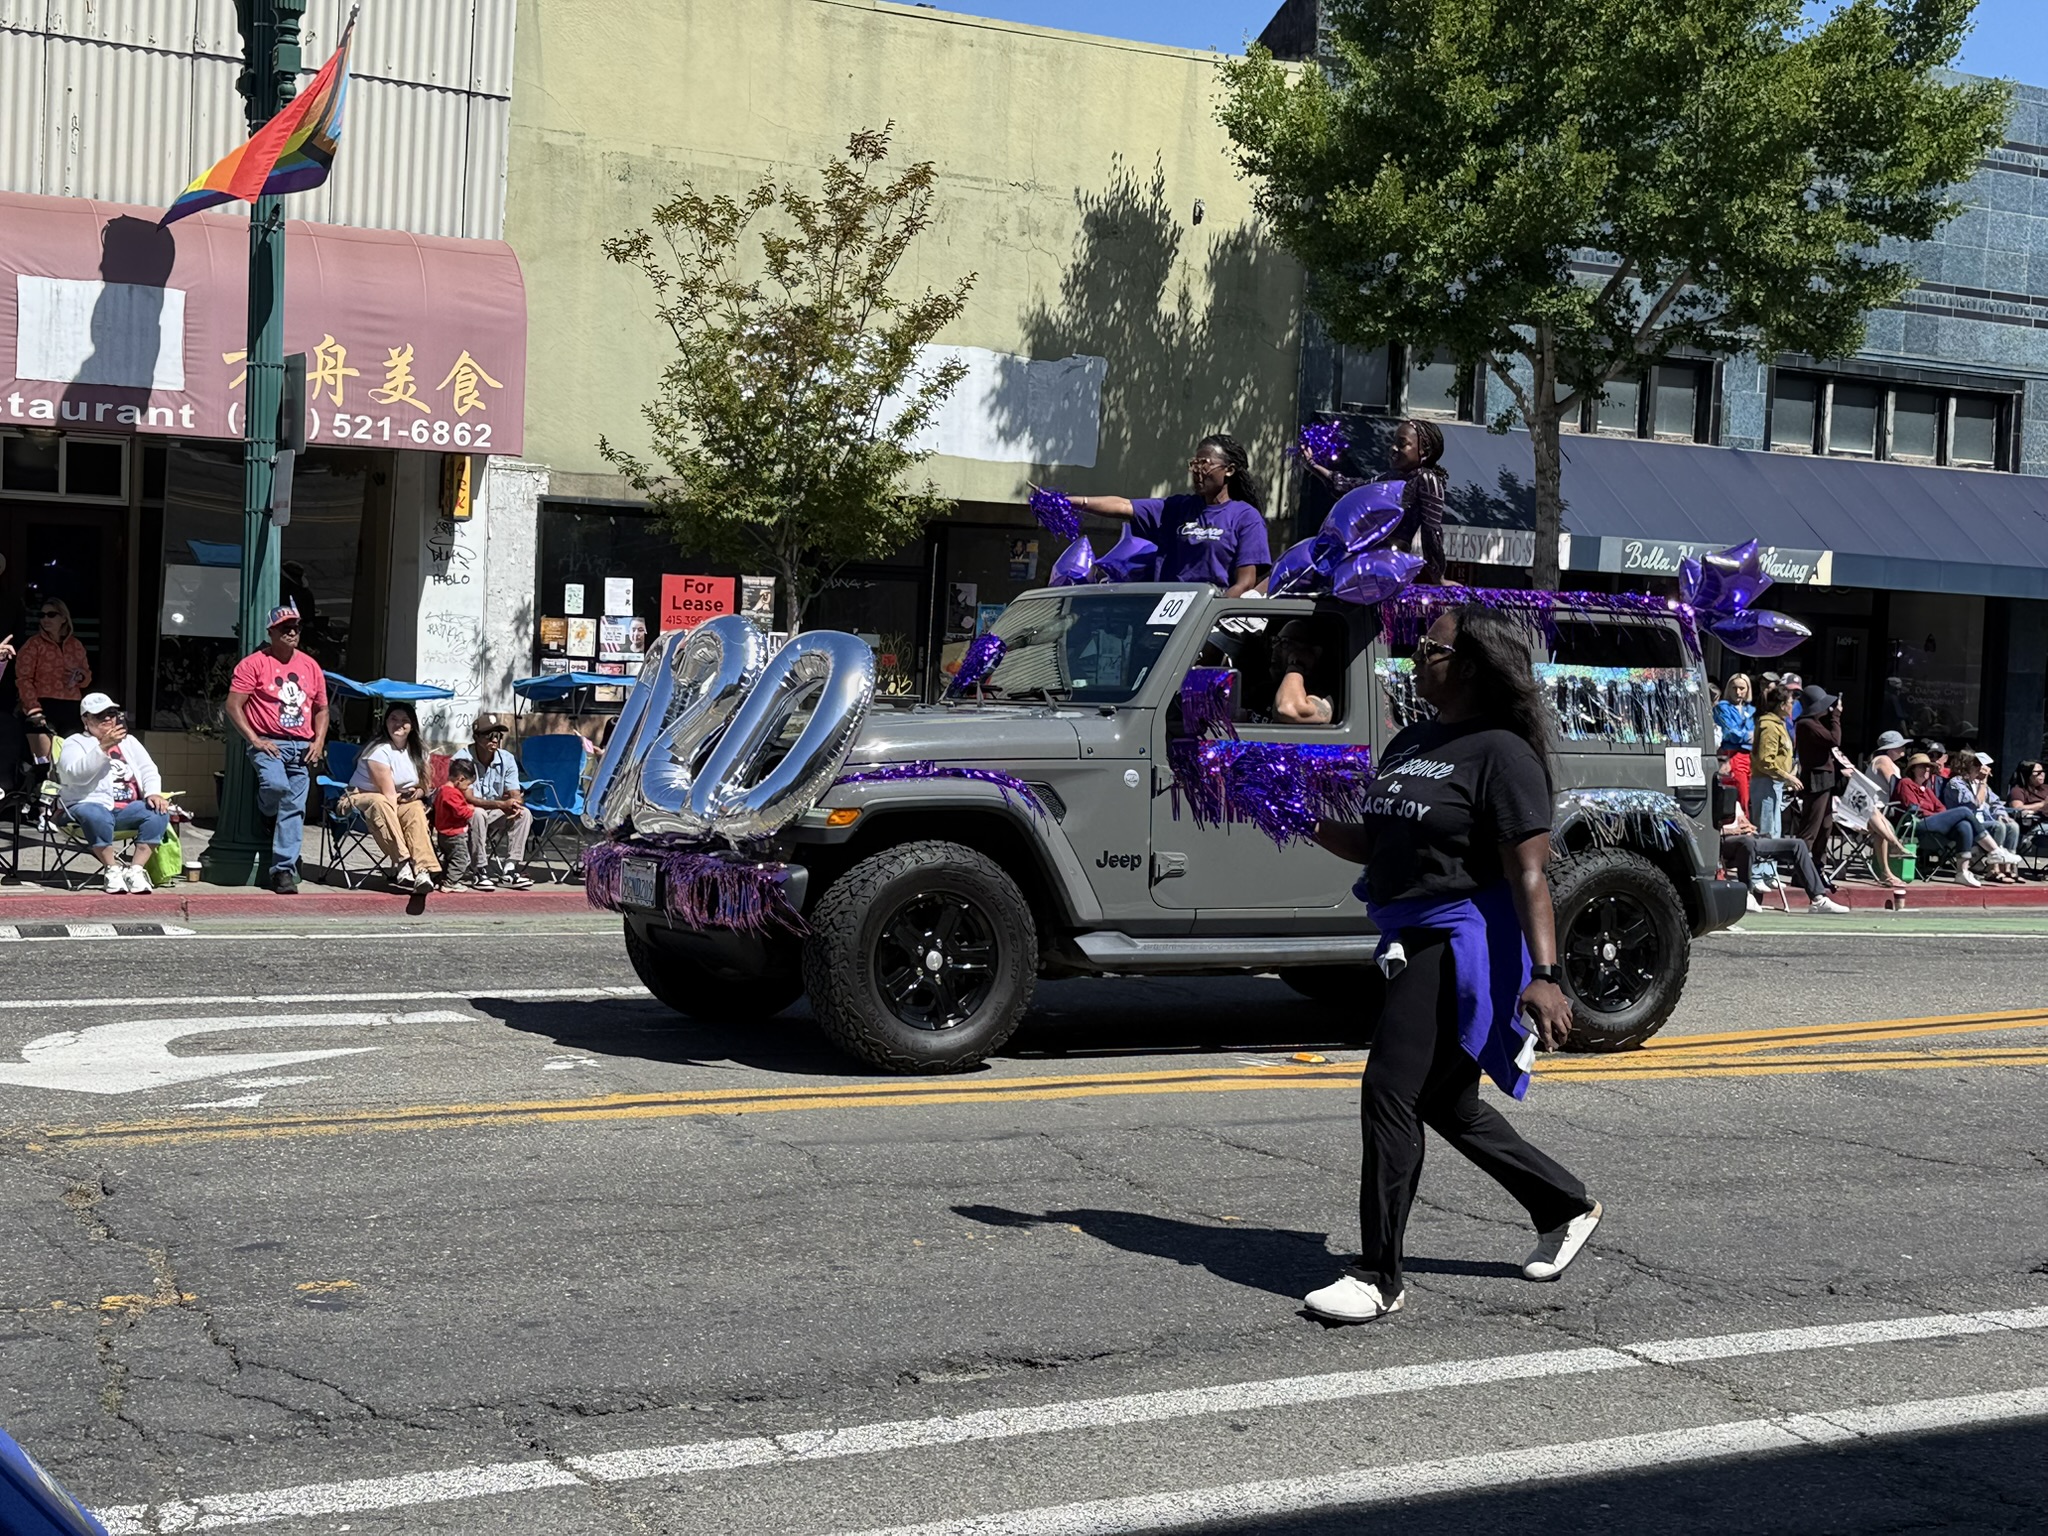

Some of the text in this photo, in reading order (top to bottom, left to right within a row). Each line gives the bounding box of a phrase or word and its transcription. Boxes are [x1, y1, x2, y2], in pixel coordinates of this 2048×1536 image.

[0, 391, 196, 429] taurant
[332, 412, 493, 449] 521-6862
[1624, 541, 1671, 571] Bella
[1758, 552, 1809, 584] Waxing
[683, 578, 714, 594] For
[672, 595, 724, 612] Lease
[1159, 599, 1184, 618] 90
[1376, 744, 1455, 781] Essence
[1675, 756, 1697, 778] 90
[1387, 780, 1403, 794] is
[1396, 799, 1432, 822] JOY
[1095, 850, 1142, 872] Jeep
